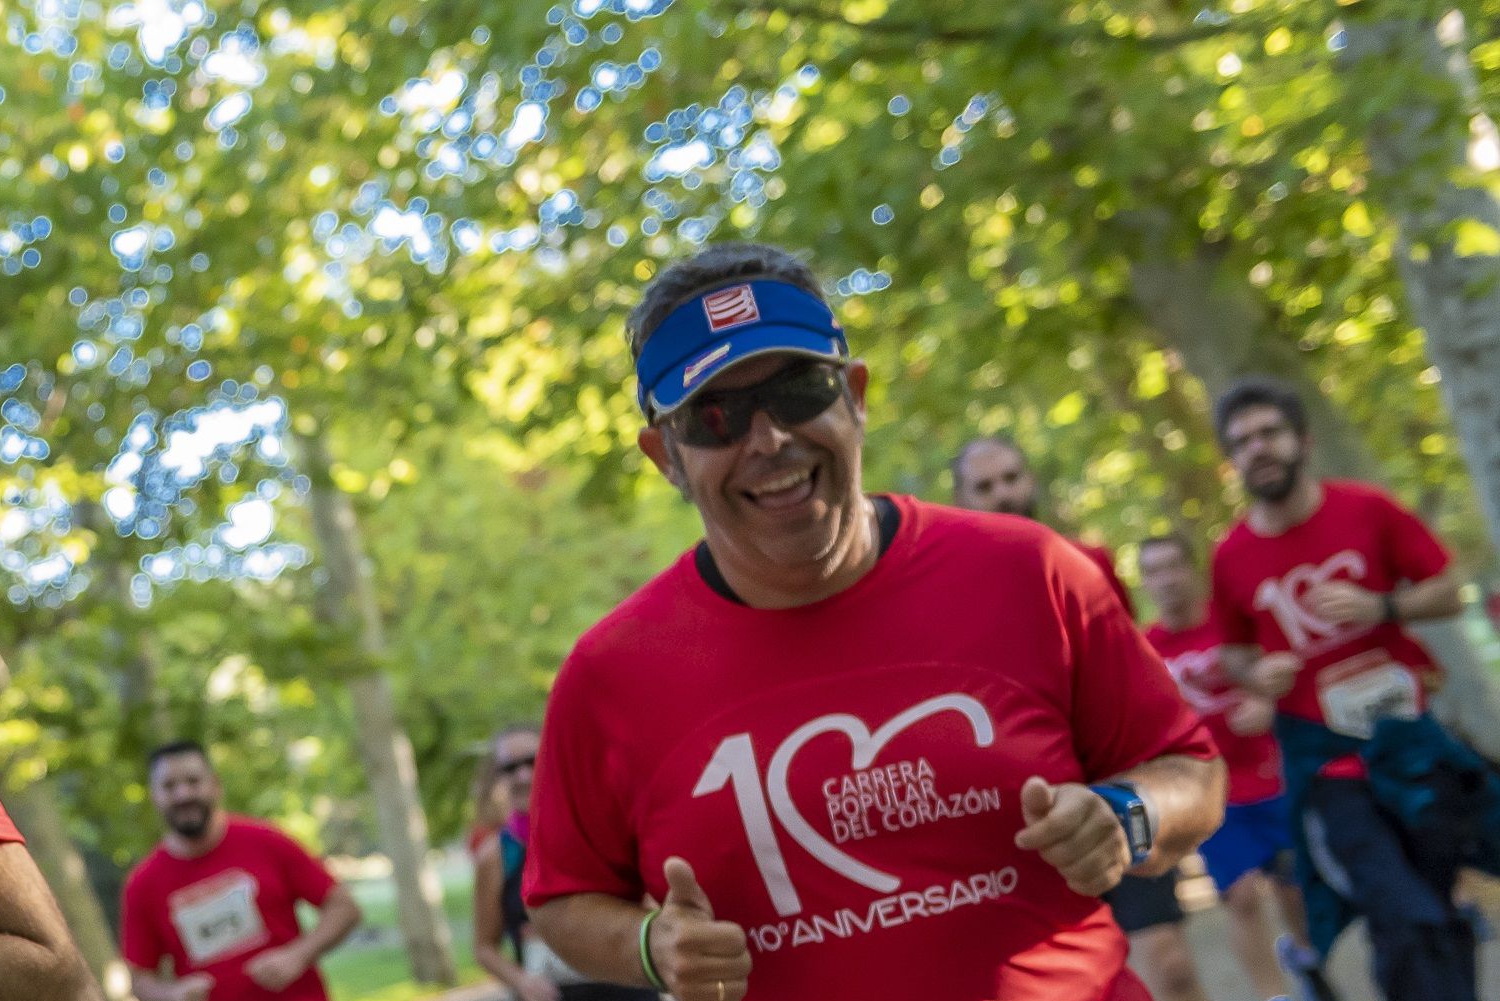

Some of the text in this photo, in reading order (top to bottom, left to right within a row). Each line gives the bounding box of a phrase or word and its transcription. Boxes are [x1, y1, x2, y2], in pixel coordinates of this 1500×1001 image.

[822, 757, 936, 800] CARRERA
[827, 779, 938, 818] POPULAR
[831, 786, 1001, 844] DEL CORAZÓN
[792, 866, 1018, 947] ANIVERSARIO
